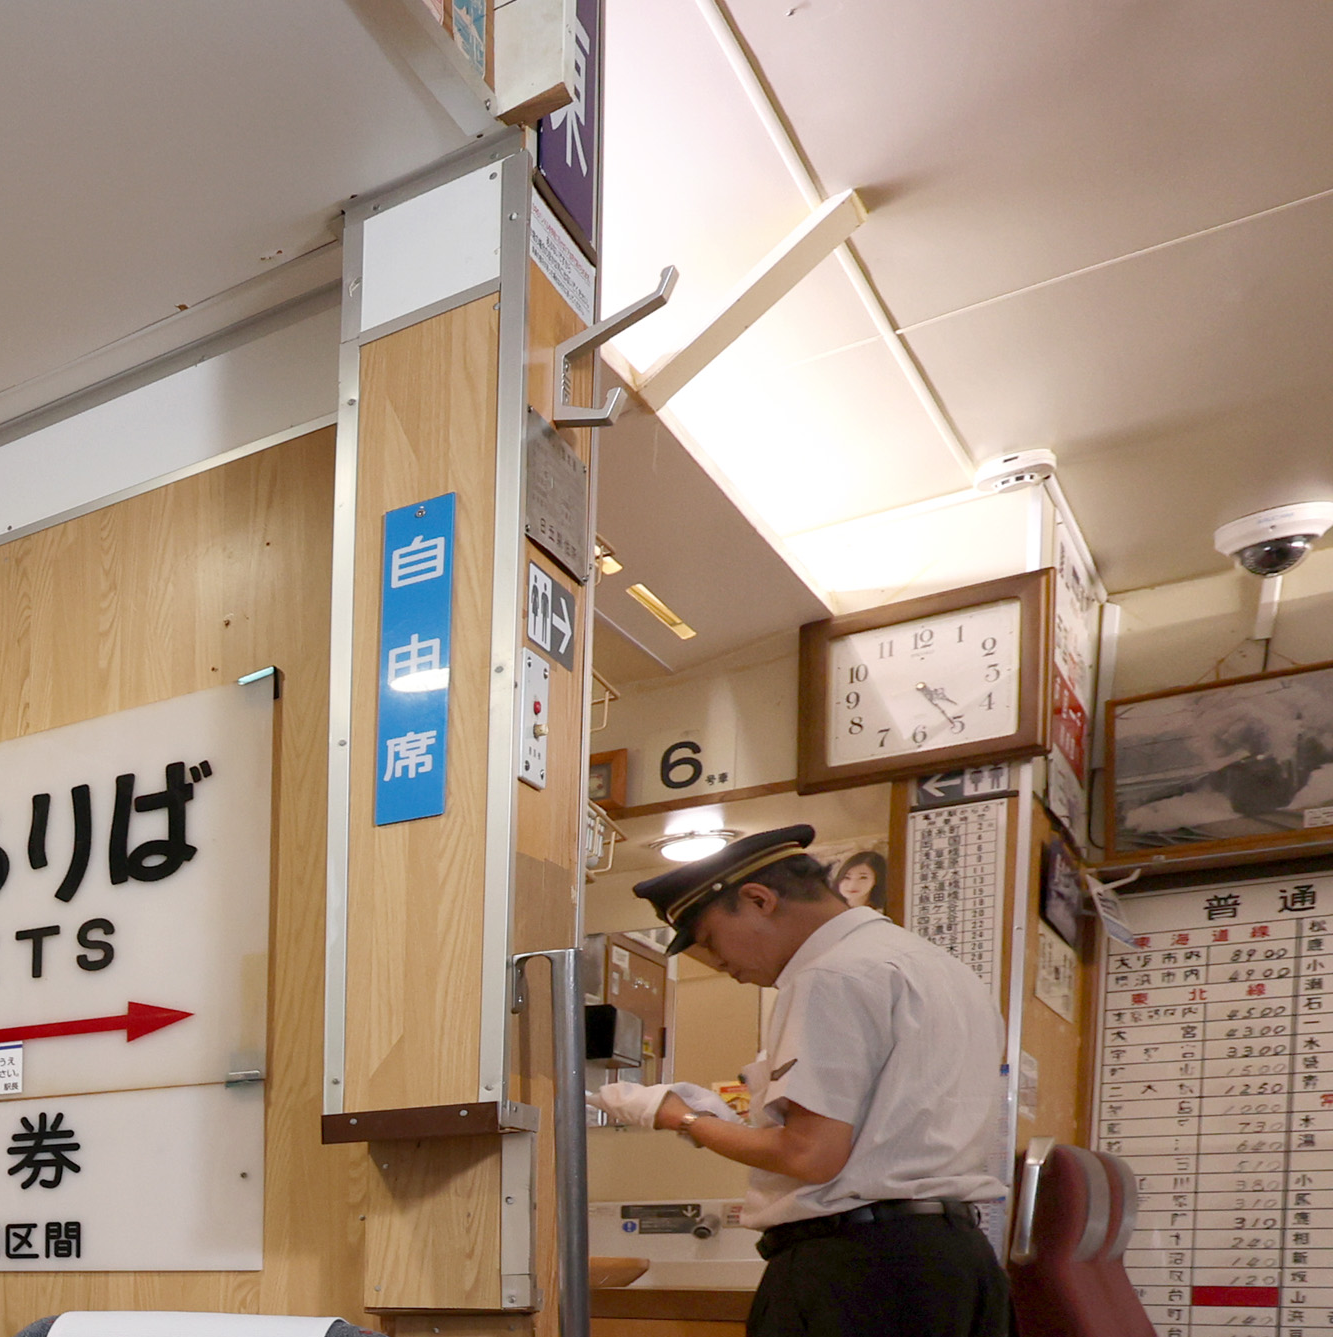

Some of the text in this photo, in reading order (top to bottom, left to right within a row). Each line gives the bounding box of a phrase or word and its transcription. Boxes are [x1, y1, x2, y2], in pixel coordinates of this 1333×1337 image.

[913, 629, 934, 650] 12
[956, 625, 964, 643] 1
[879, 640, 894, 659] 11
[981, 637, 997, 657] 2
[383, 534, 447, 783] 自由席
[848, 663, 869, 684] 10
[985, 663, 1000, 682] 3
[846, 691, 860, 710] 9
[979, 692, 995, 710] 4
[848, 716, 864, 735] 8
[950, 715, 966, 734] 5
[877, 728, 891, 747] 7
[912, 725, 927, 744] 6
[1203, 884, 1318, 920] 普通
[1230, 948, 1288, 962] 8900
[1132, 983, 1267, 1006] 東北線
[3, 1081, 19, 1091] 駅長
